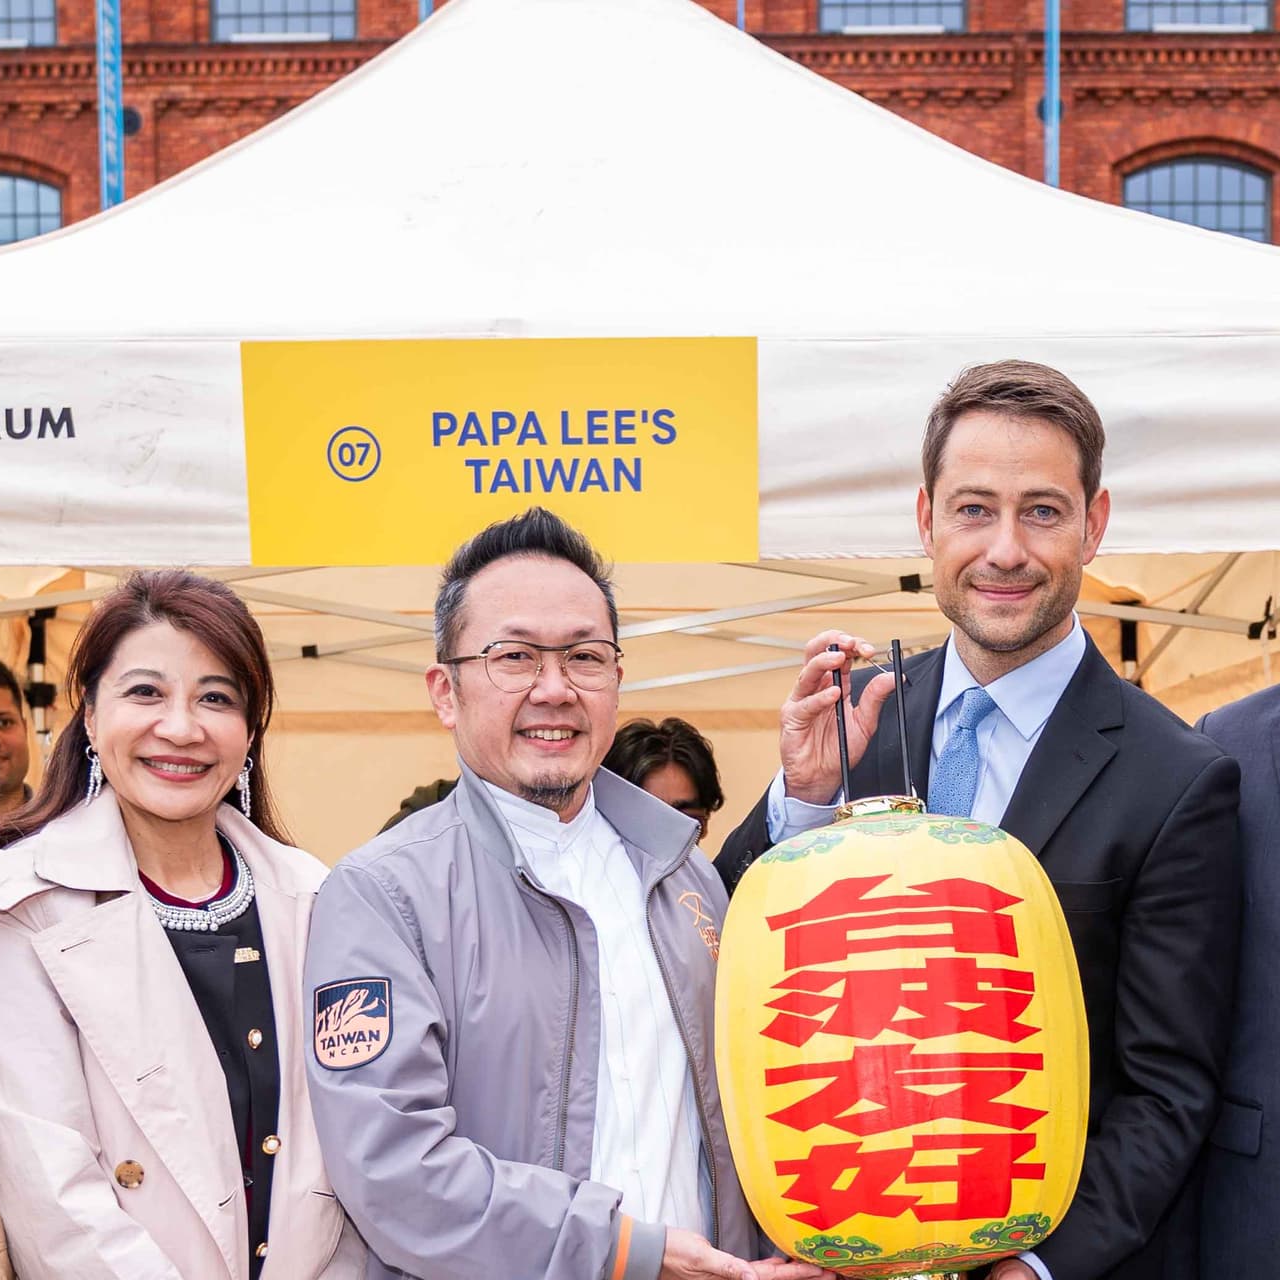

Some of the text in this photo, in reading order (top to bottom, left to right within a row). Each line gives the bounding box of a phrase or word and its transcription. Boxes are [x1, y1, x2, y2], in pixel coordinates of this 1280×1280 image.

[432, 408, 678, 447] PAPA LEE'S
[338, 442, 371, 467] 07
[464, 457, 643, 494] TAIWAN
[320, 1029, 381, 1051] TAIWAN
